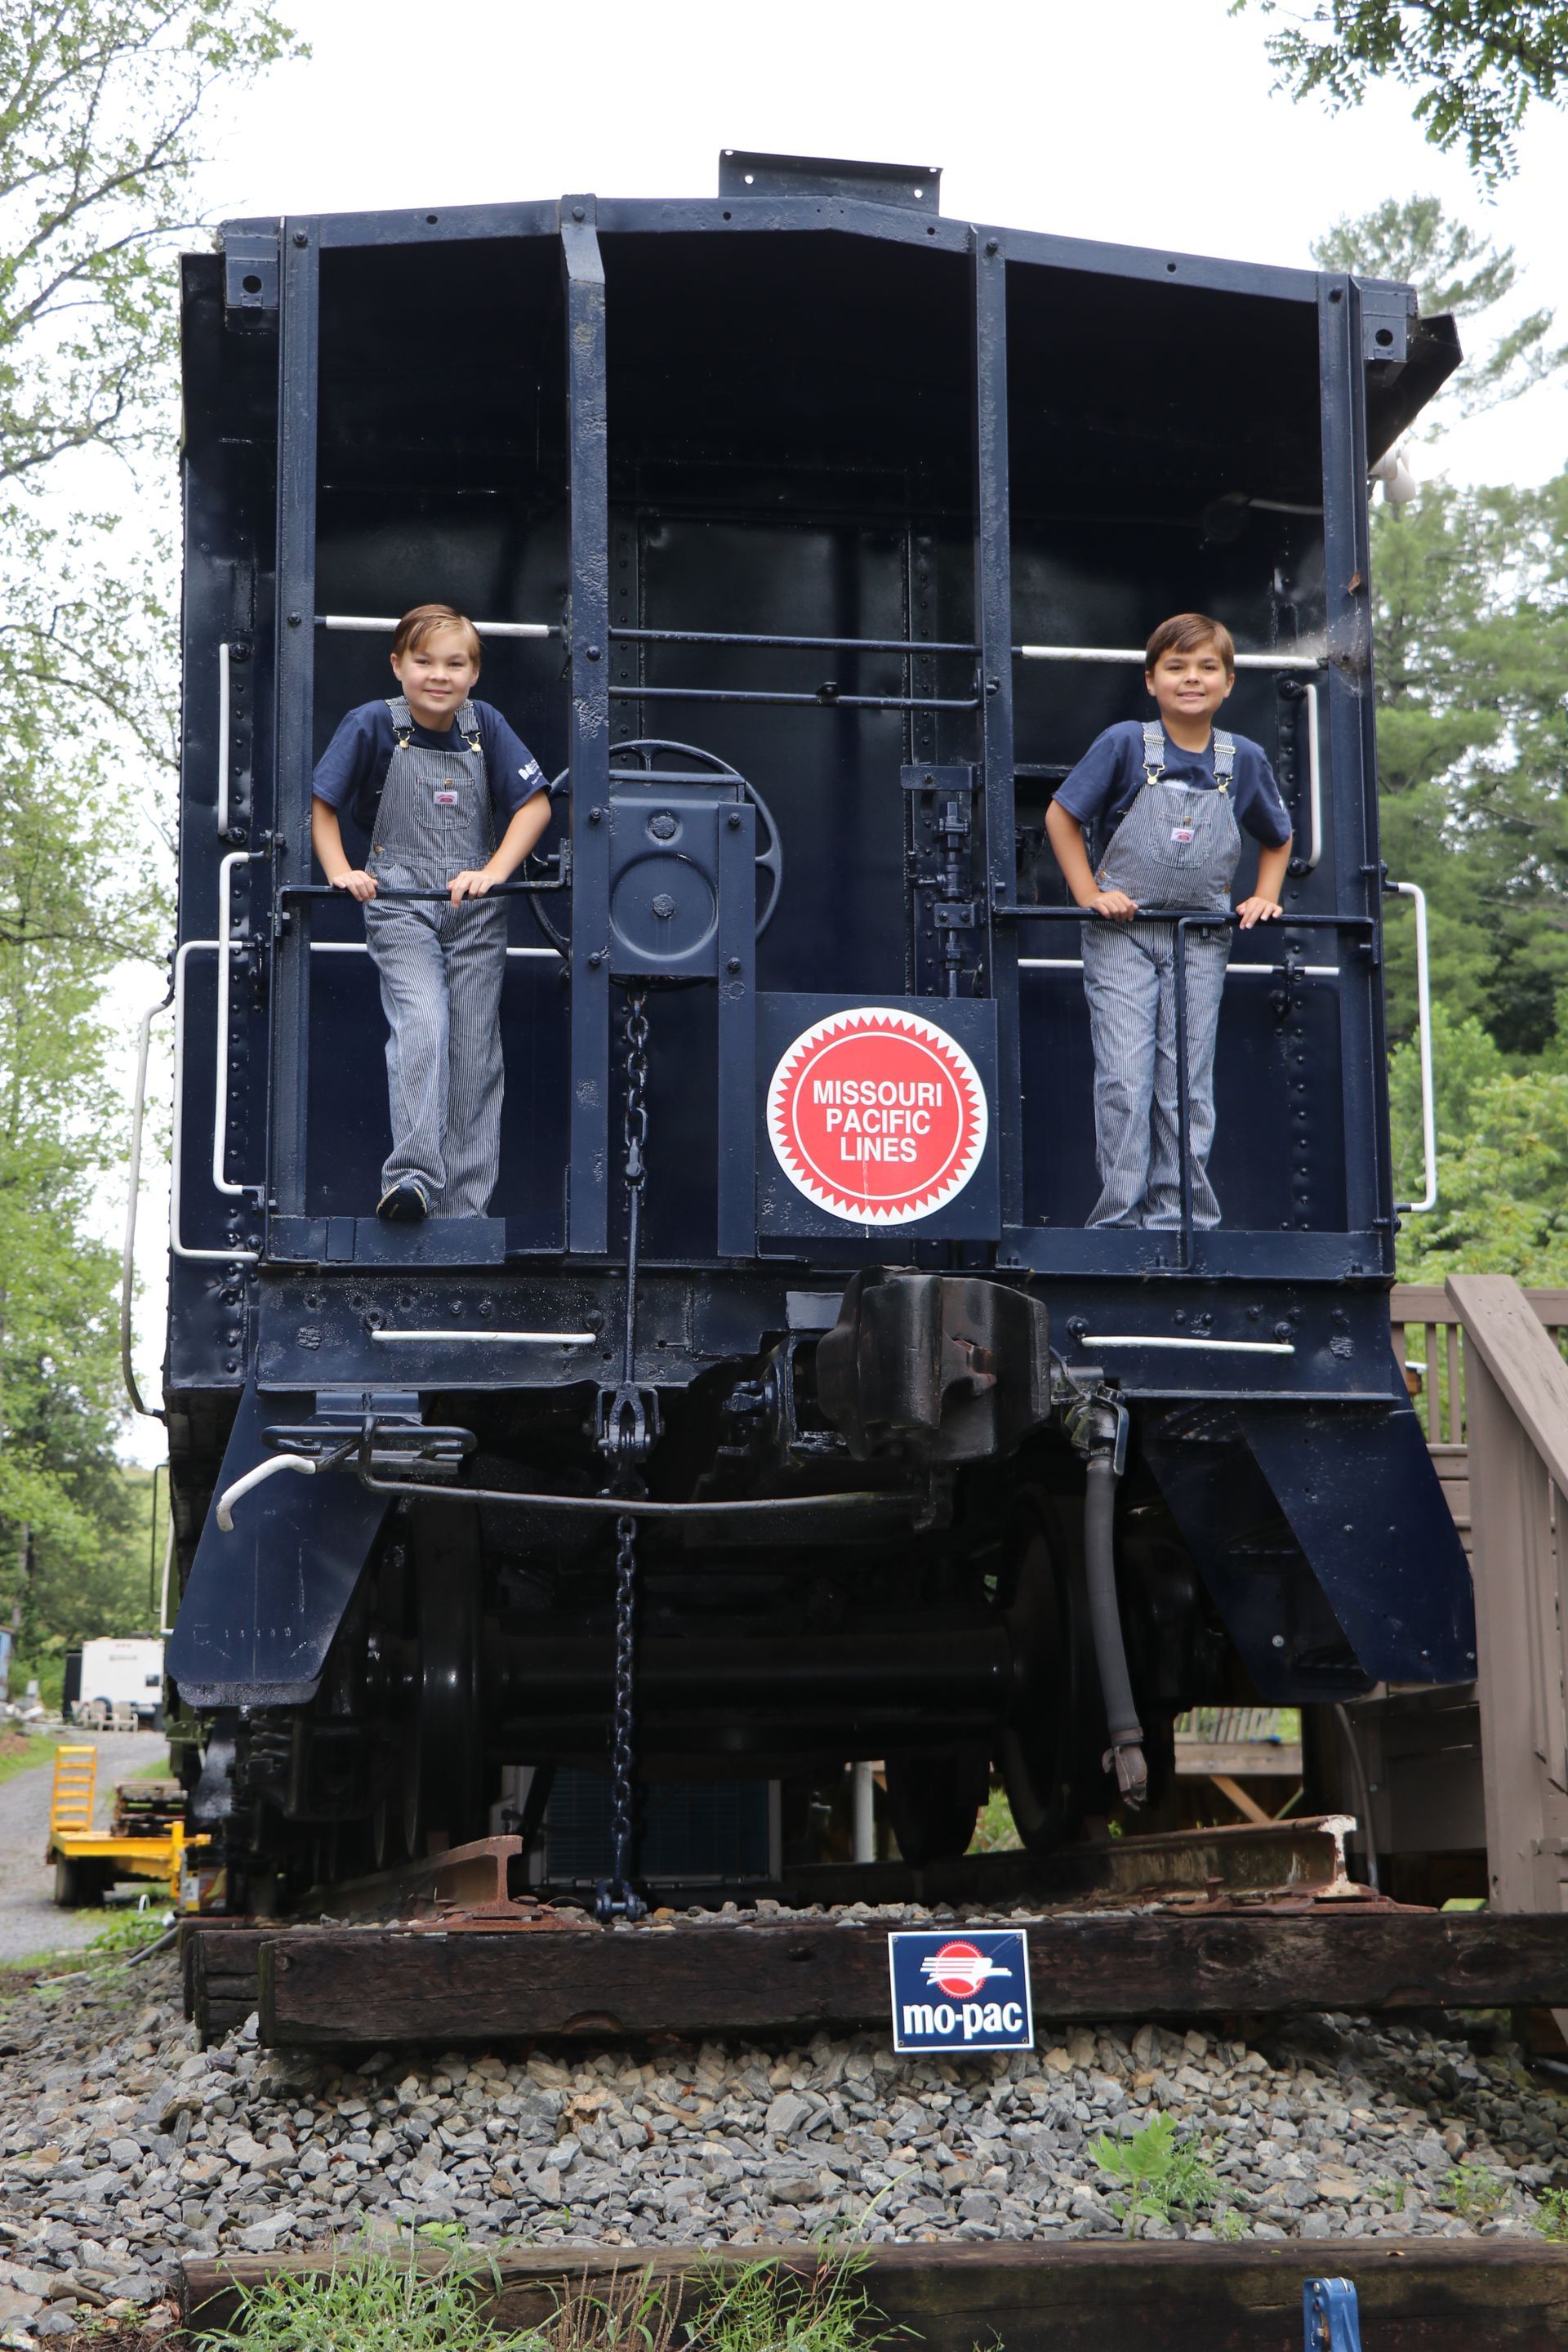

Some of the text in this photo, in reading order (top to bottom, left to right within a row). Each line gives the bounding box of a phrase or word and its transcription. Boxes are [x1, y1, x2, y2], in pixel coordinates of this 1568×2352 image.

[813, 1080, 942, 1107] MISSOURI
[826, 1108, 931, 1135] PACIFIC
[840, 1136, 917, 1163] LINES
[902, 2002, 1023, 2040] mo-pac
